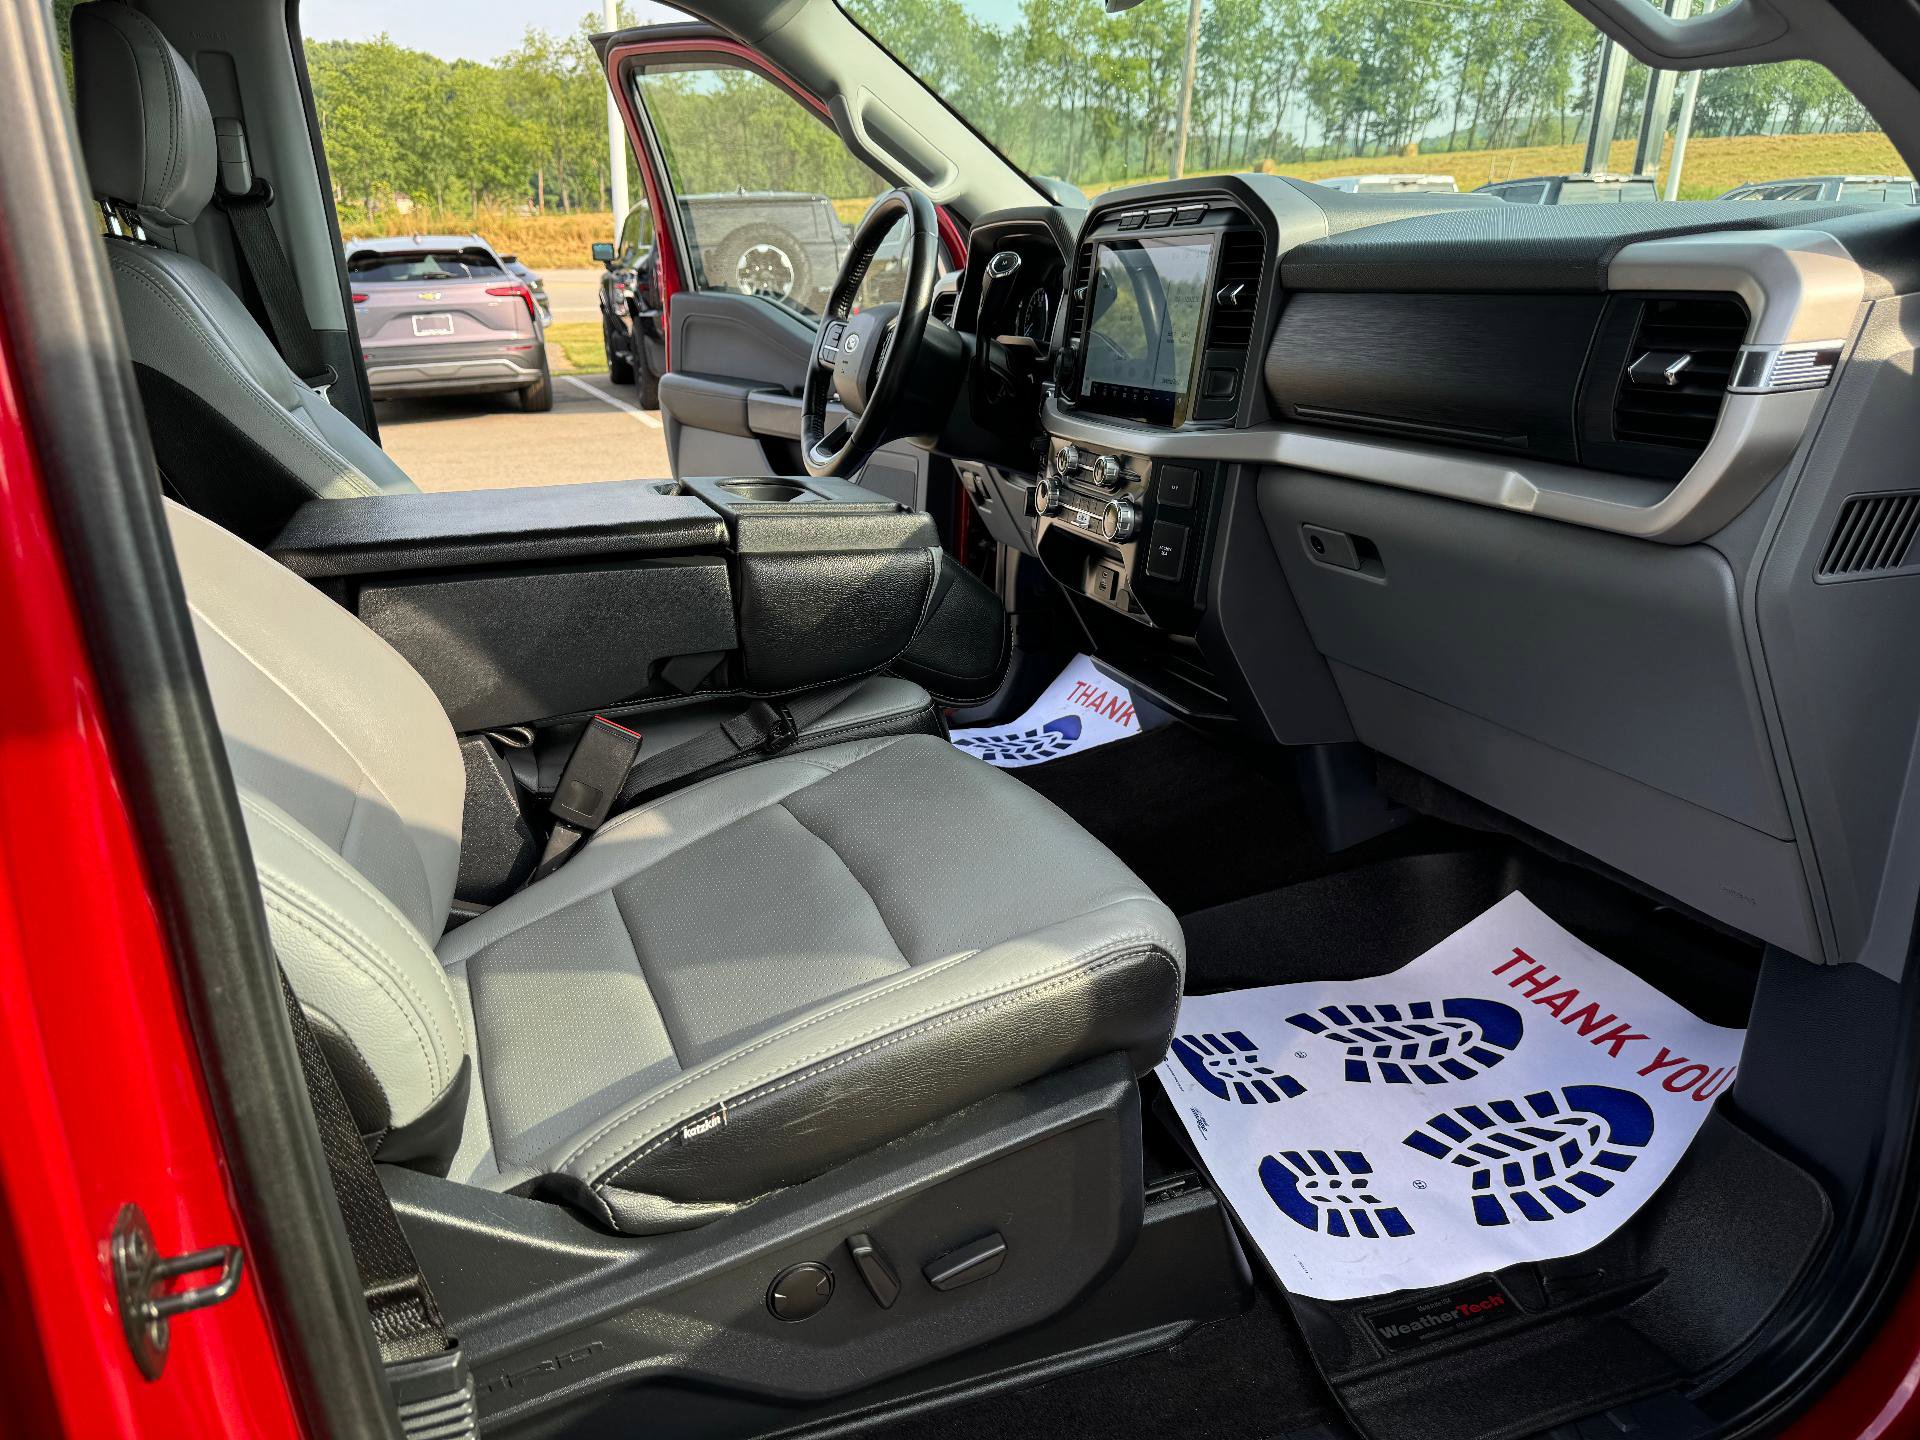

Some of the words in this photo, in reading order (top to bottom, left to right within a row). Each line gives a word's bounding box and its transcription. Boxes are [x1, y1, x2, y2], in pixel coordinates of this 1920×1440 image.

[1066, 681, 1137, 728] THANK
[1491, 946, 1651, 1058] THANK
[1636, 1046, 1737, 1102] YOU
[683, 1115, 721, 1139] katzkin
[1379, 1294, 1505, 1339] WeatherTech
